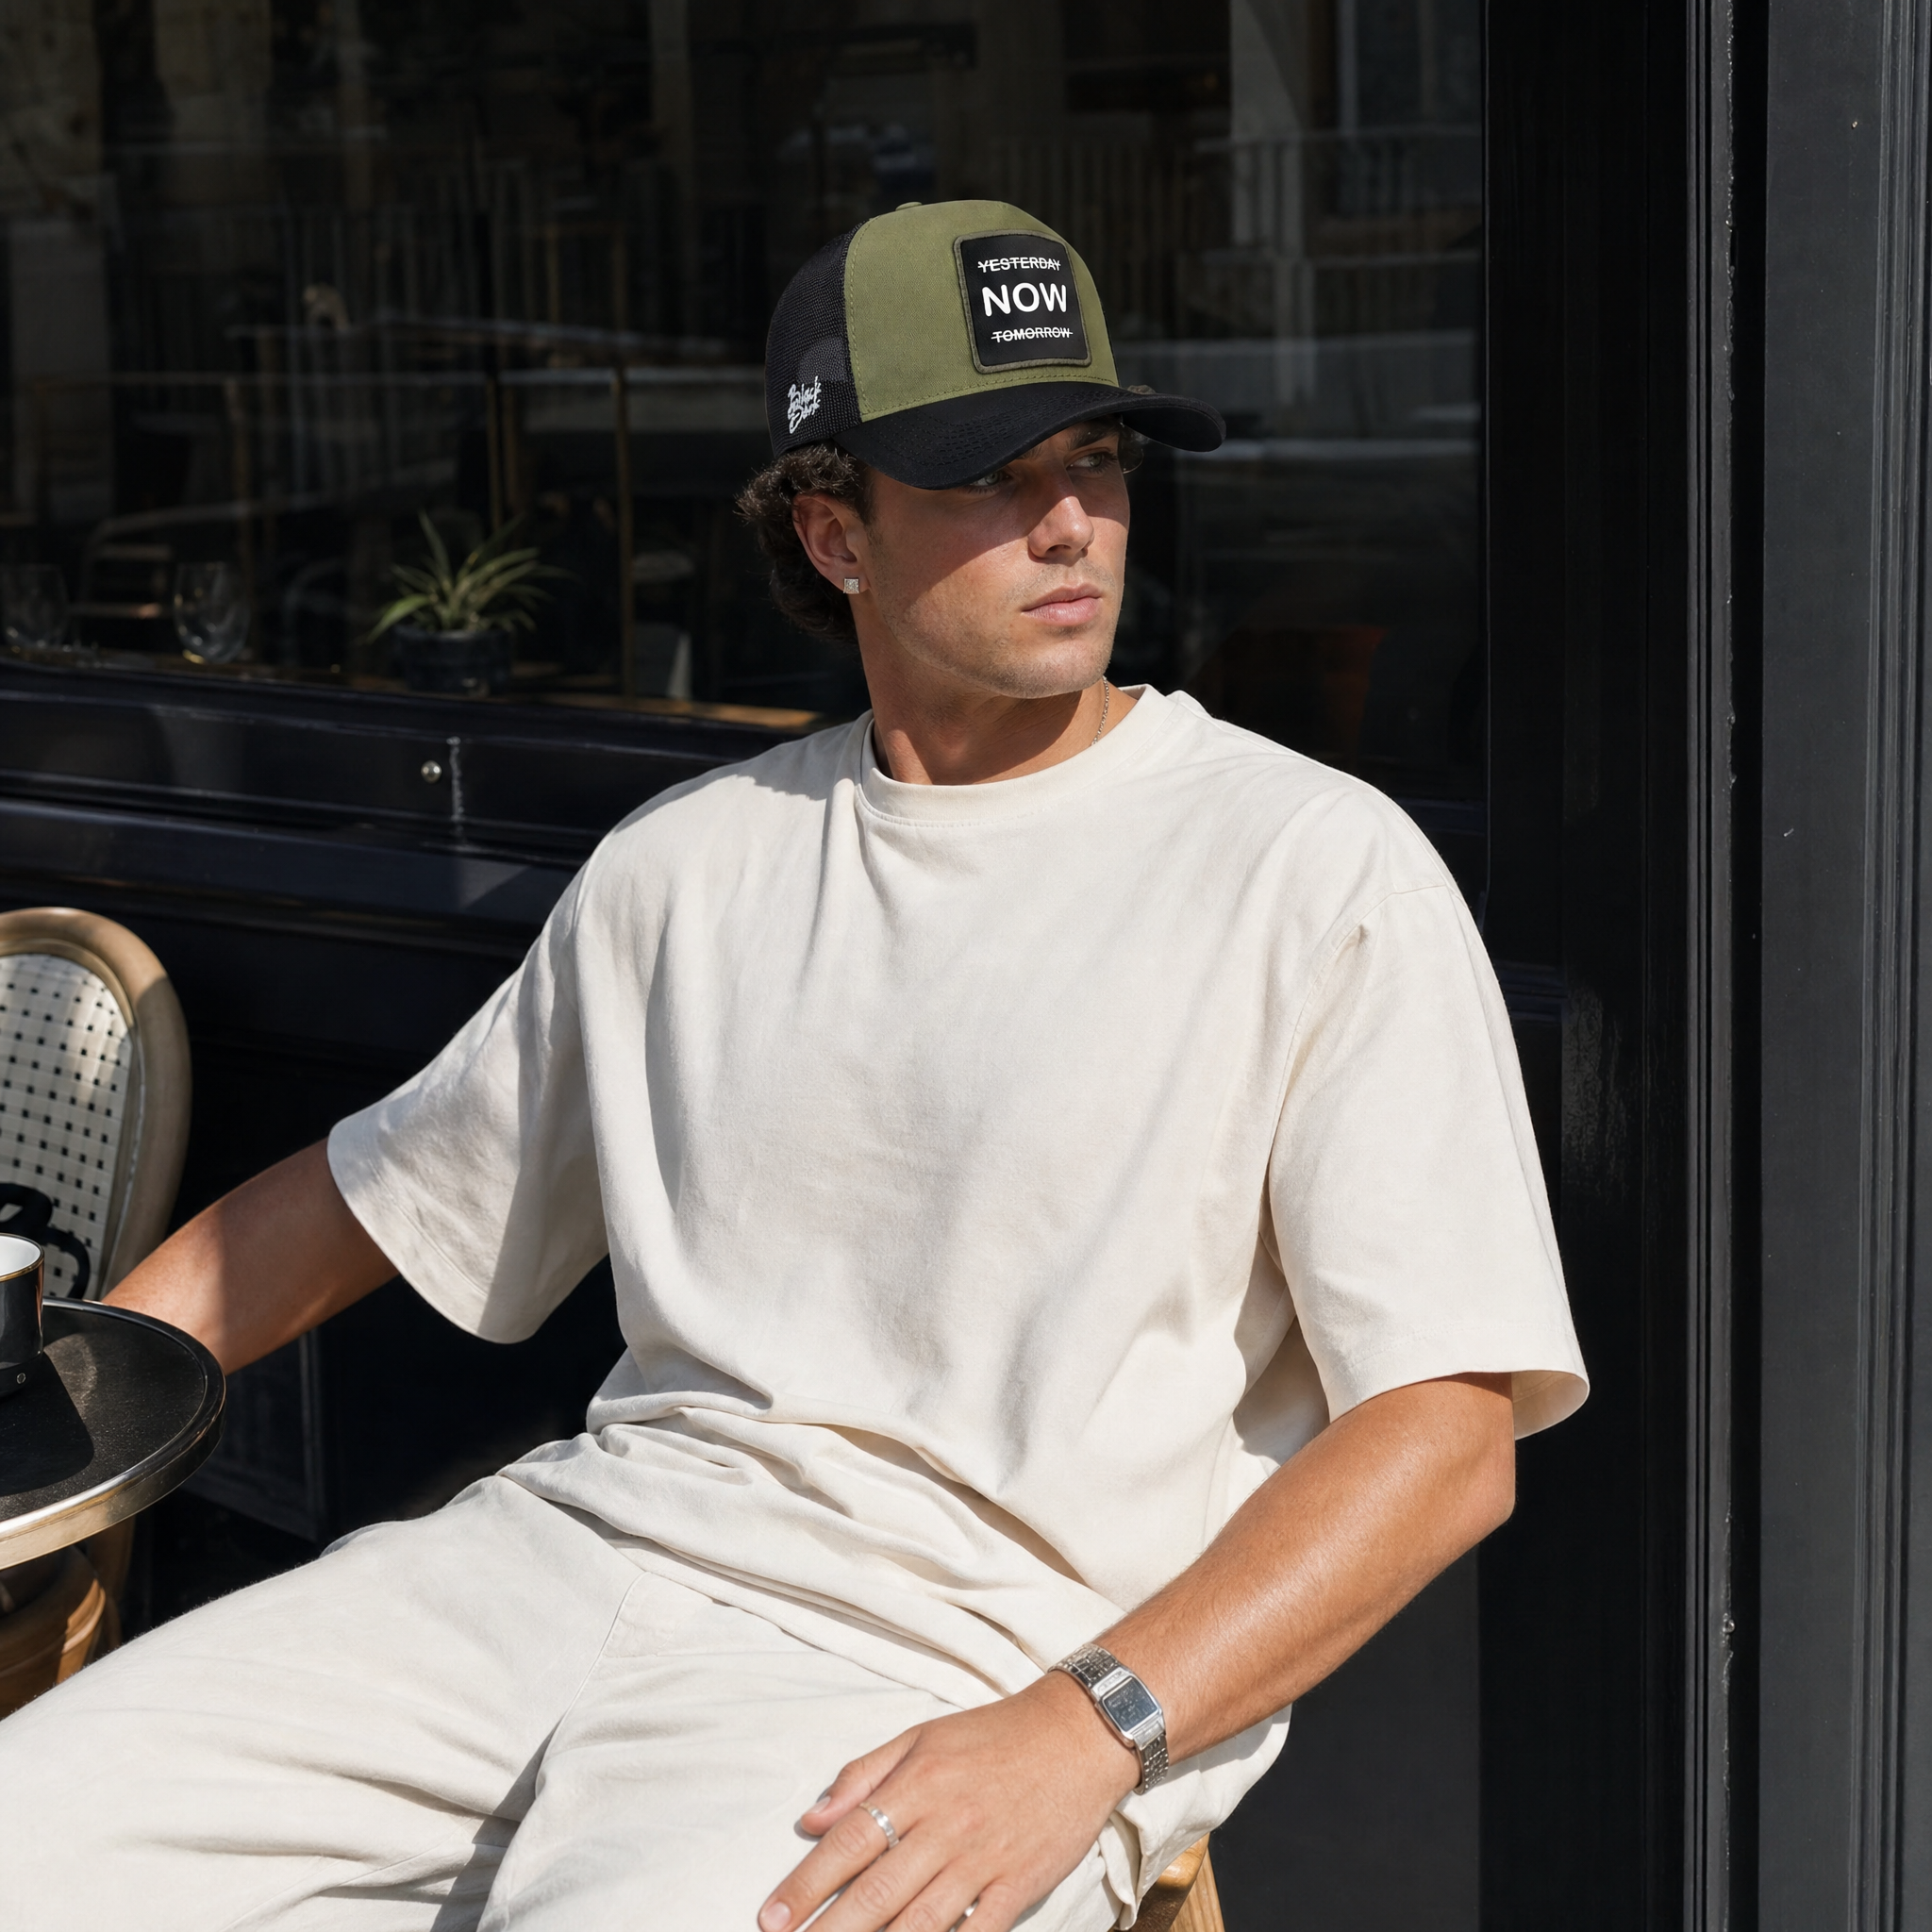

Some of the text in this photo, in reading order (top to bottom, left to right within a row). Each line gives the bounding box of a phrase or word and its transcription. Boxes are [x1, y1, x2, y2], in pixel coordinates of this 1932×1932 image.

[978, 258, 1060, 273] YESTERDAY
[982, 282, 1067, 317] NOW
[991, 327, 1072, 342] TOMORROW
